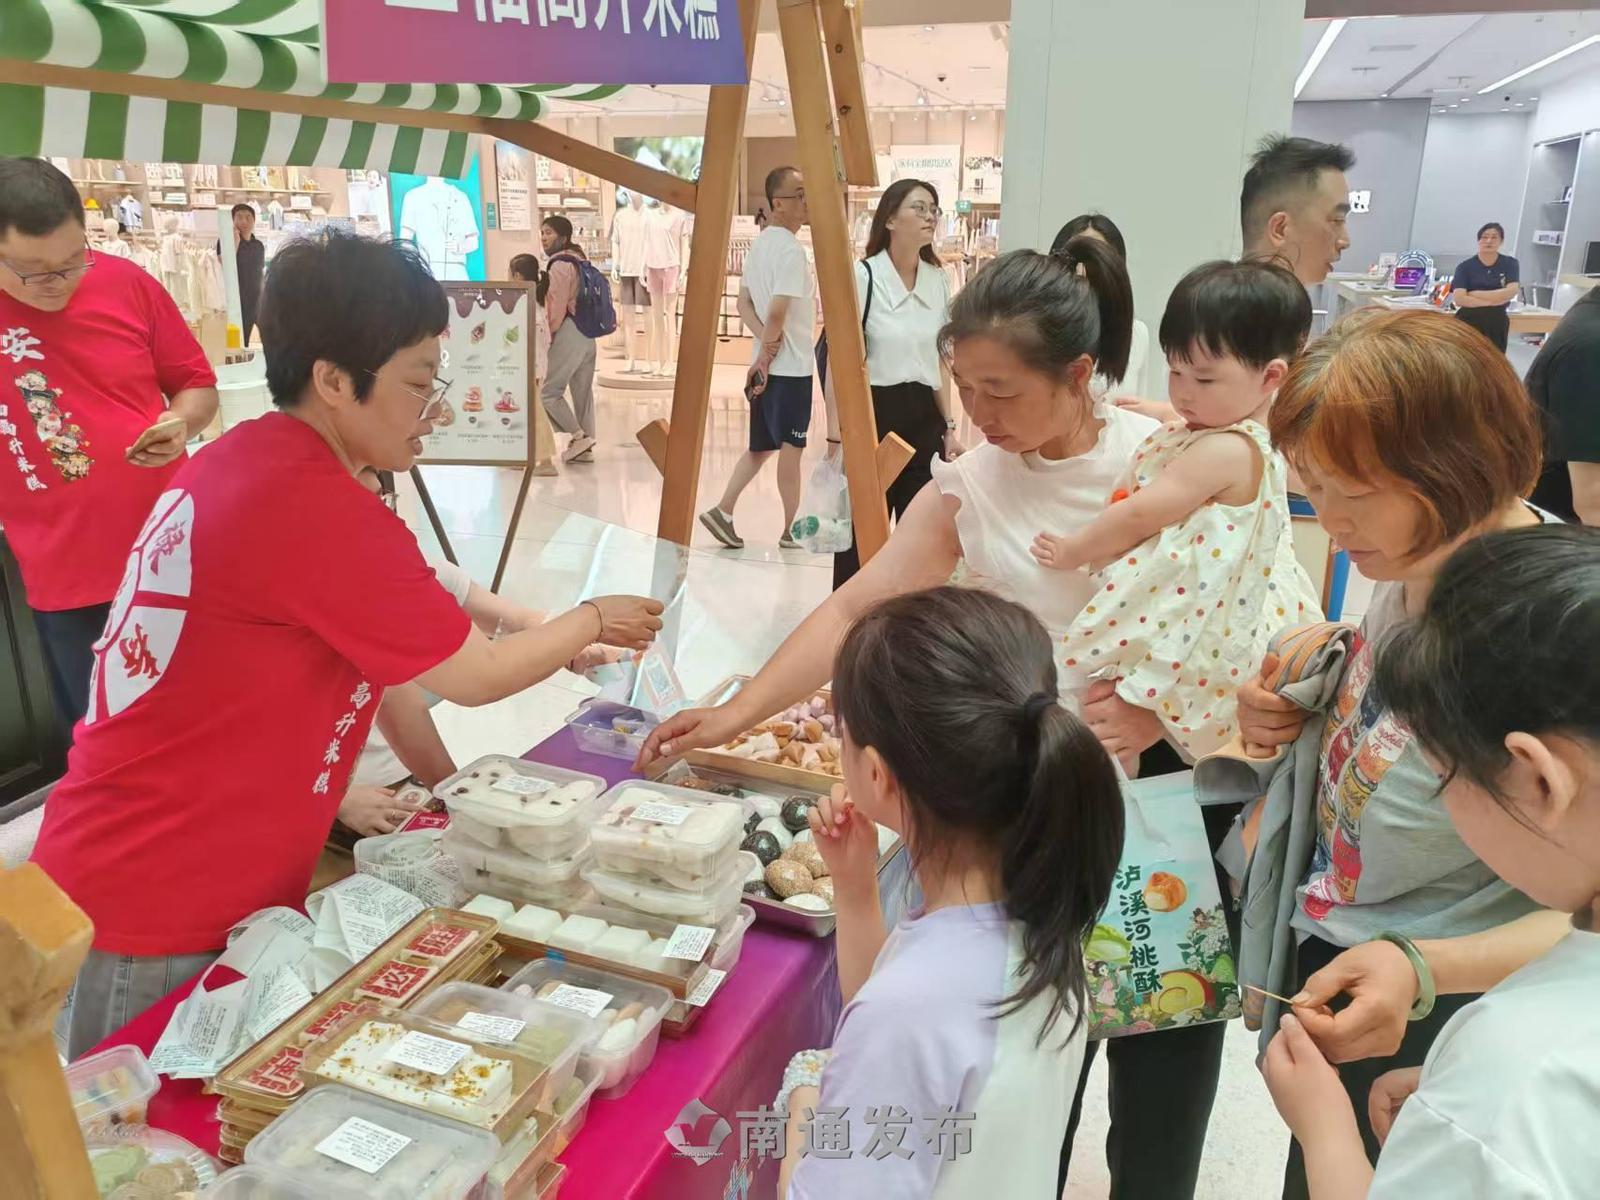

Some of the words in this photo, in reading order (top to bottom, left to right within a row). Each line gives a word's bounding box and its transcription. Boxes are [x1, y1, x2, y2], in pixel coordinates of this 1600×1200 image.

[312, 681, 372, 795] 高升米糕
[1116, 865, 1164, 993] 泸溪河桃酥
